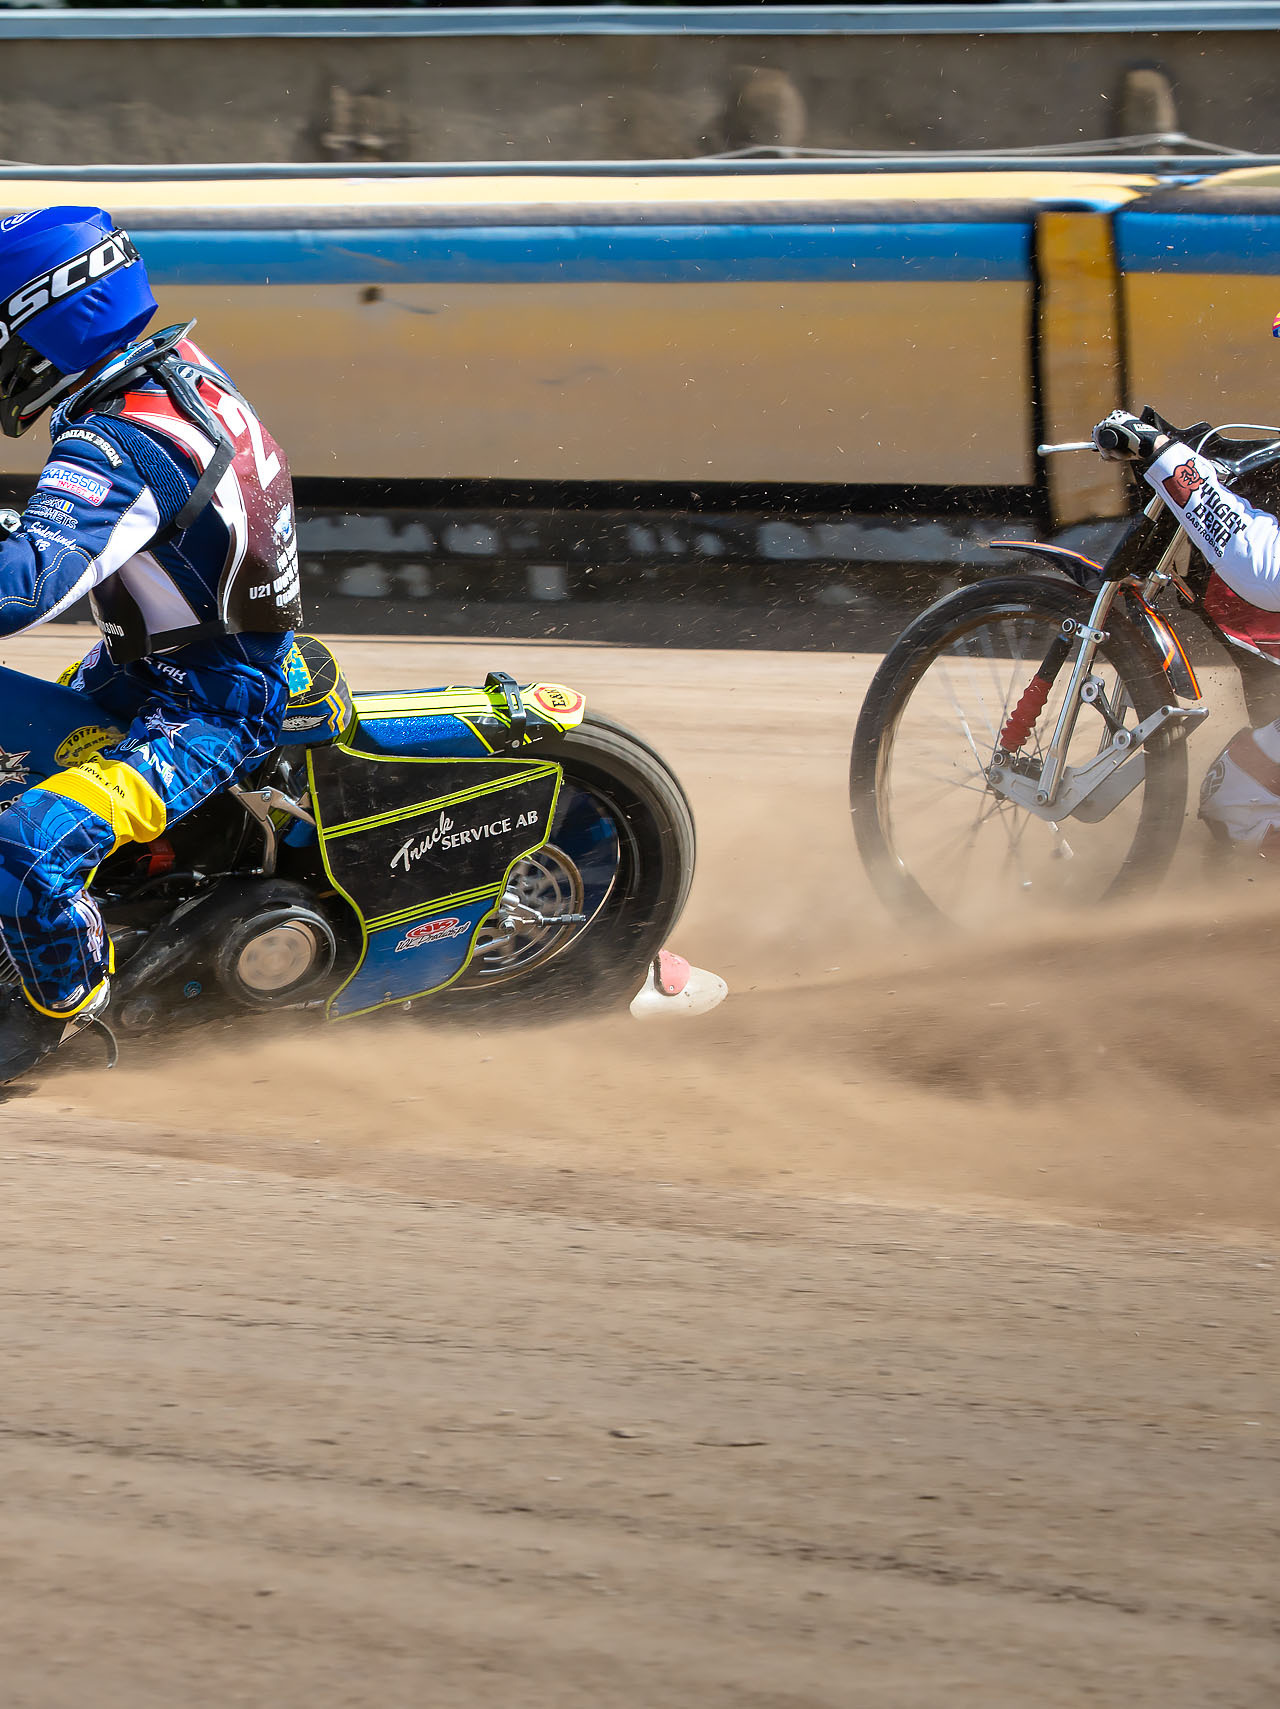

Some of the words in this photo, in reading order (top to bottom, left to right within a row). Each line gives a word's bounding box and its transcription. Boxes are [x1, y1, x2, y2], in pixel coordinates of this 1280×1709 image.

[9, 230, 130, 331] SCO
[56, 480, 88, 496] INVEST
[1200, 482, 1247, 536] YOGGY
[249, 583, 272, 600] U21
[390, 811, 454, 872] Truck
[441, 818, 512, 851] SERVICE
[516, 810, 539, 829] AB
